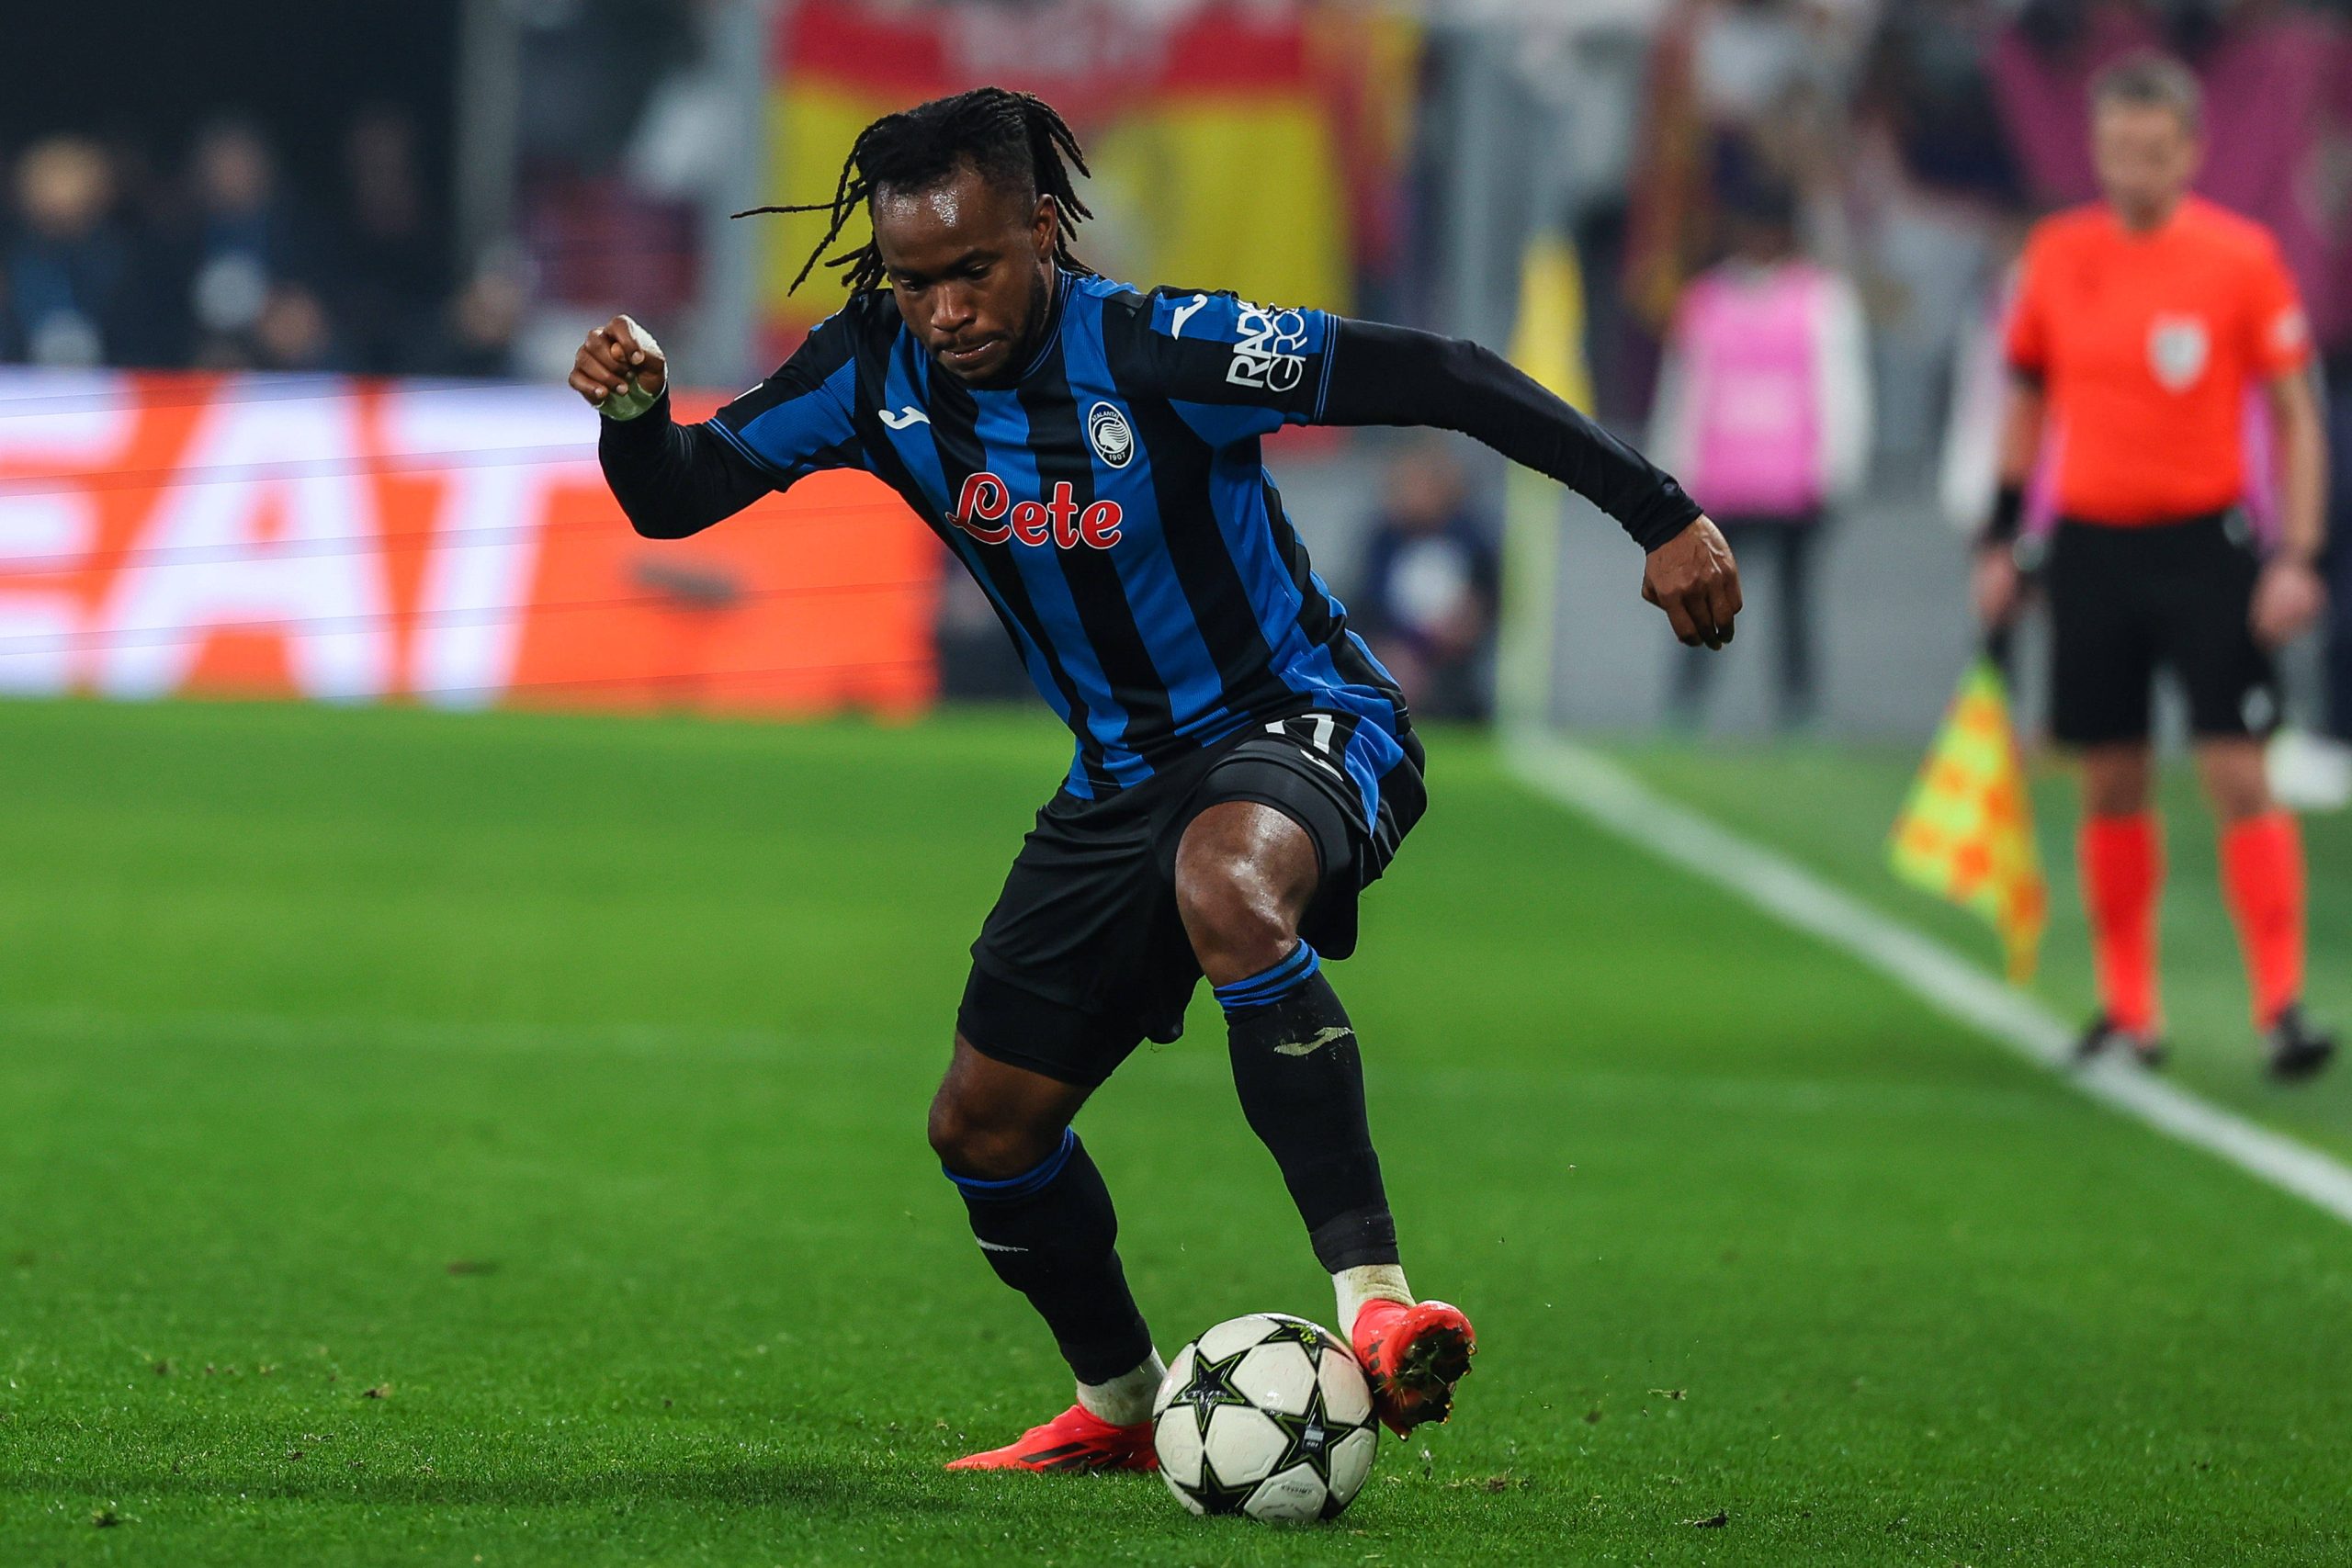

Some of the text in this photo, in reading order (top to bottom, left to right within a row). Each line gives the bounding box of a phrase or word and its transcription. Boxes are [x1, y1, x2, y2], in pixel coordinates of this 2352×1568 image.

[1266, 303, 1308, 392] GRO
[1091, 411, 1118, 423] ATALANTA
[1108, 452, 1125, 461] 1907
[945, 471, 1123, 549] Lete
